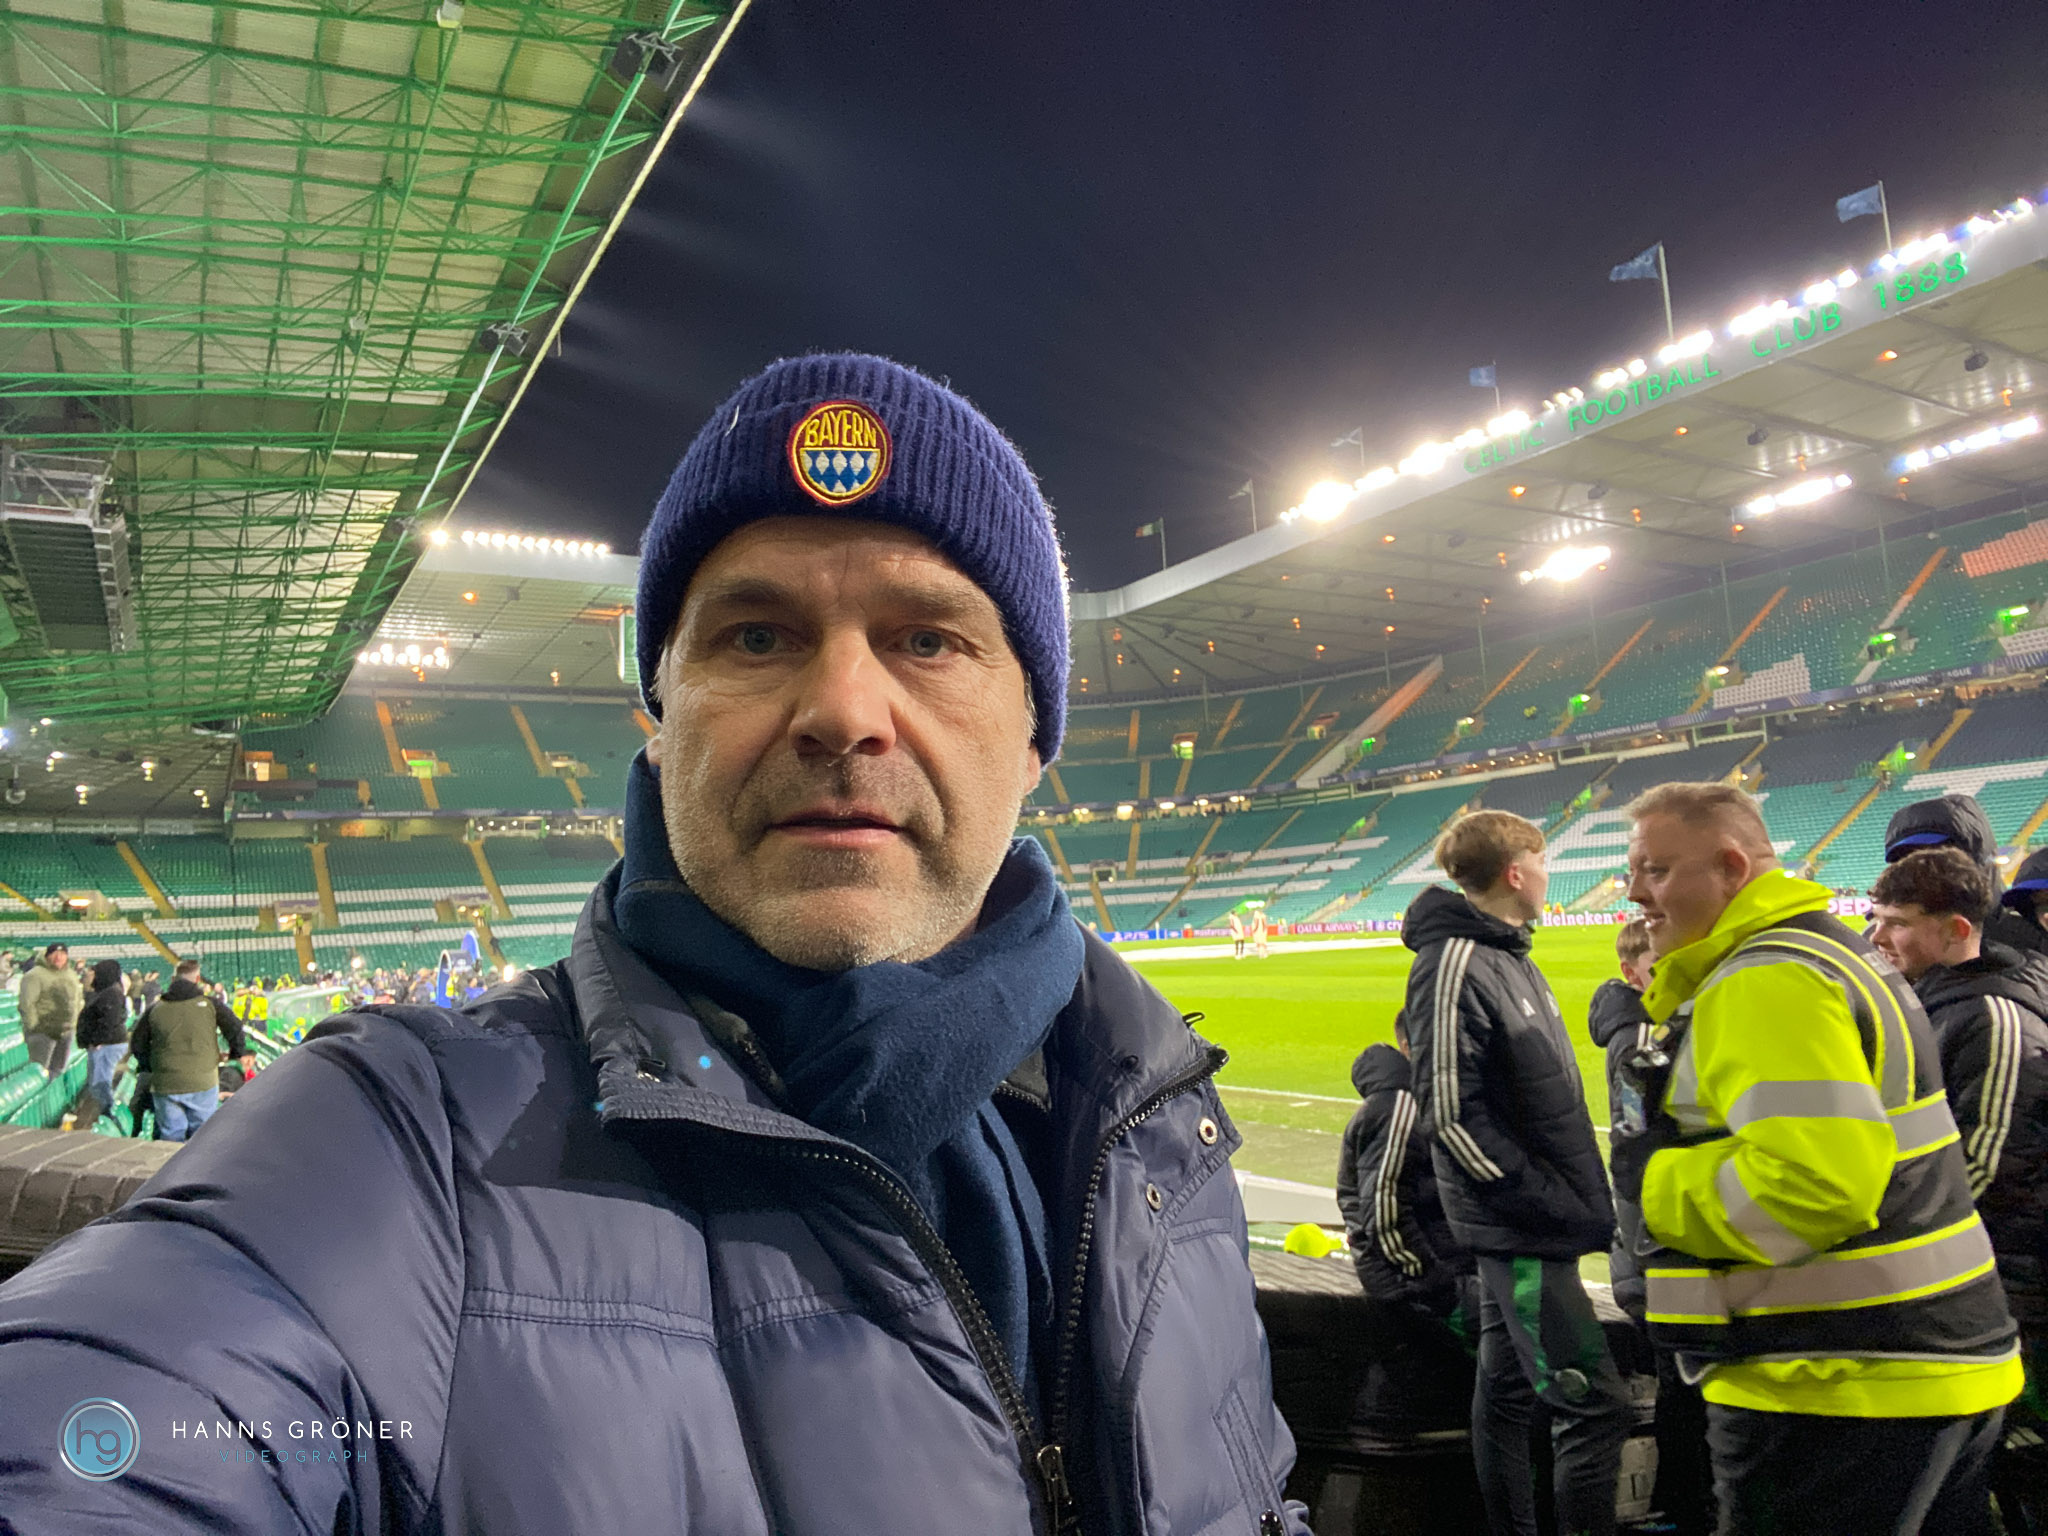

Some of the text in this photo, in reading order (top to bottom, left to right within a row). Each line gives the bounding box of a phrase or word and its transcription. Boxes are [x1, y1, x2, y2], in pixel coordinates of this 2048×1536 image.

[1464, 251, 1968, 473] CELTIC FOOTBALL CLUB 1888
[803, 409, 877, 448] BAYERN
[1297, 921, 1359, 934] QATAR AIRWAYS
[1542, 910, 1614, 927] Heineken
